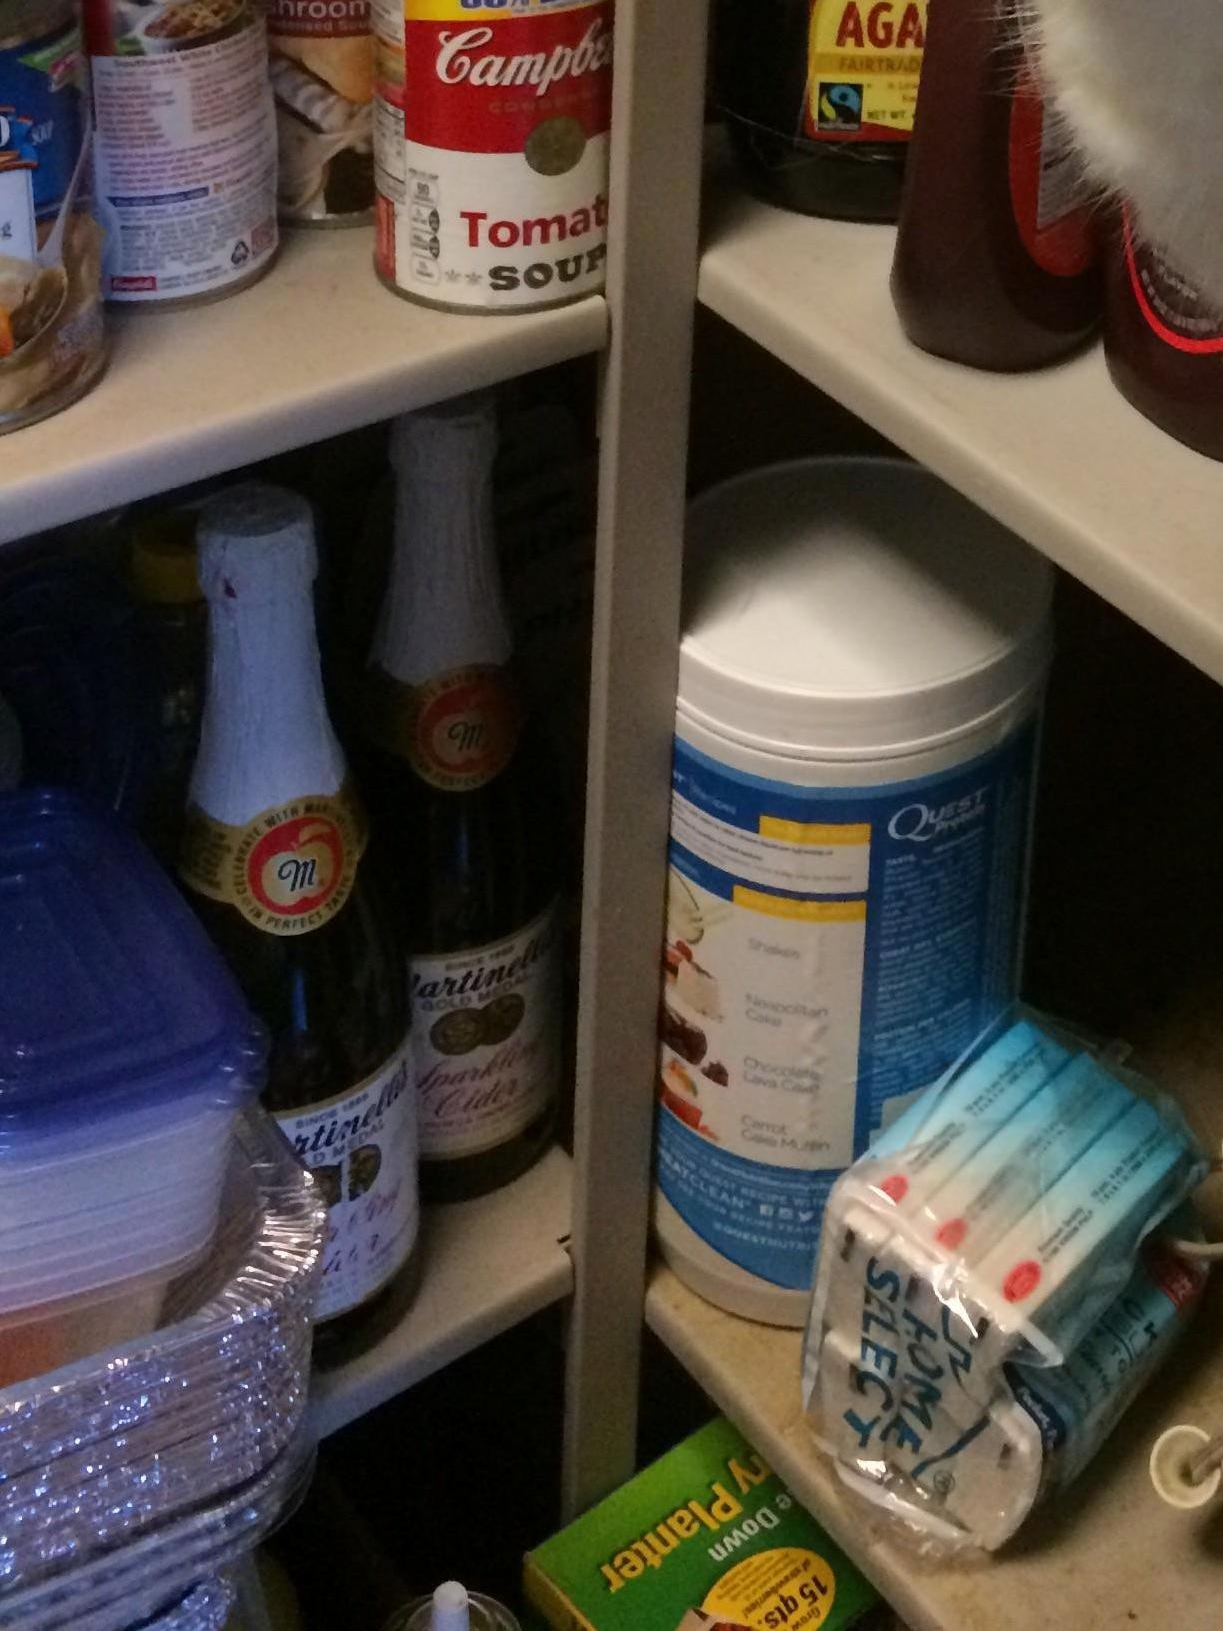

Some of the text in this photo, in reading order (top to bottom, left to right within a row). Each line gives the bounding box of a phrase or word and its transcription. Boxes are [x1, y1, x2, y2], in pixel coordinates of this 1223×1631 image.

[835, 0, 926, 50] AGA
[838, 55, 921, 75] FAIRTRAD
[459, 193, 609, 249] Tomat
[263, 806, 300, 829] WITH
[887, 784, 991, 843] QUEST
[276, 857, 318, 893] M
[265, 910, 324, 930] PERFECT
[600, 1480, 744, 1594] Planter
[706, 1506, 780, 1563] Down
[750, 1572, 831, 1631] 15 qts.
[787, 1605, 822, 1631] Grow
